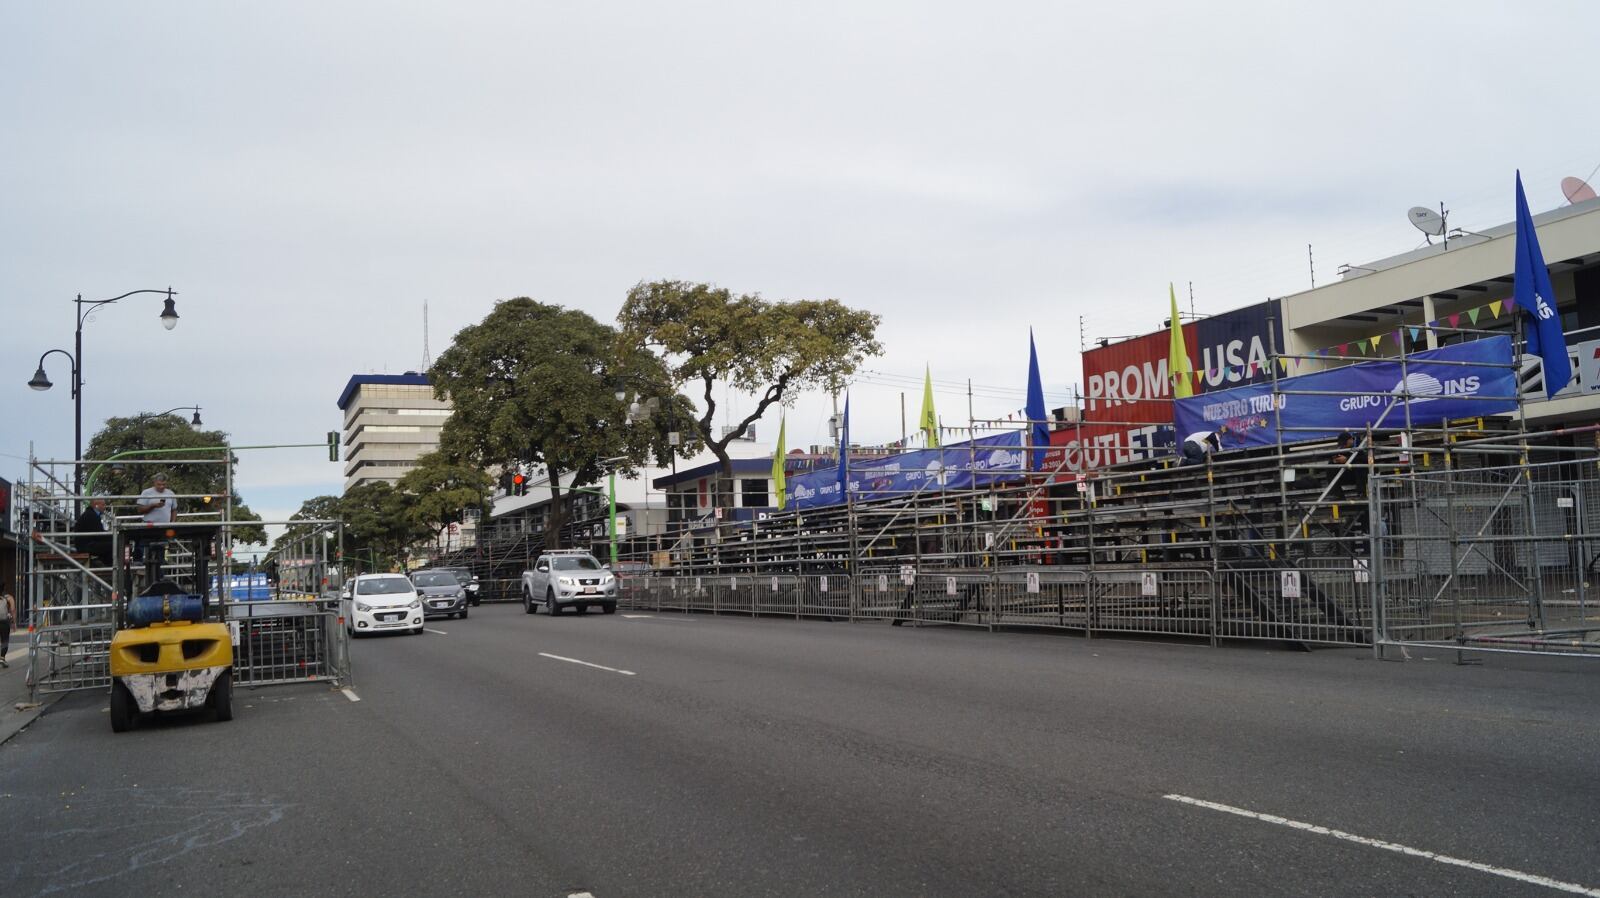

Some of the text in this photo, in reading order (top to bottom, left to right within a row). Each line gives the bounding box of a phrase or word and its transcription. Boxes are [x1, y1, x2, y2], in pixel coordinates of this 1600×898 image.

[1535, 293, 1554, 319] NS
[1089, 335, 1271, 412] PROM USA
[1203, 398, 1248, 422] NUESTRO
[1340, 375, 1480, 412] GRUPO INS
[1065, 425, 1158, 472] OUTLET
